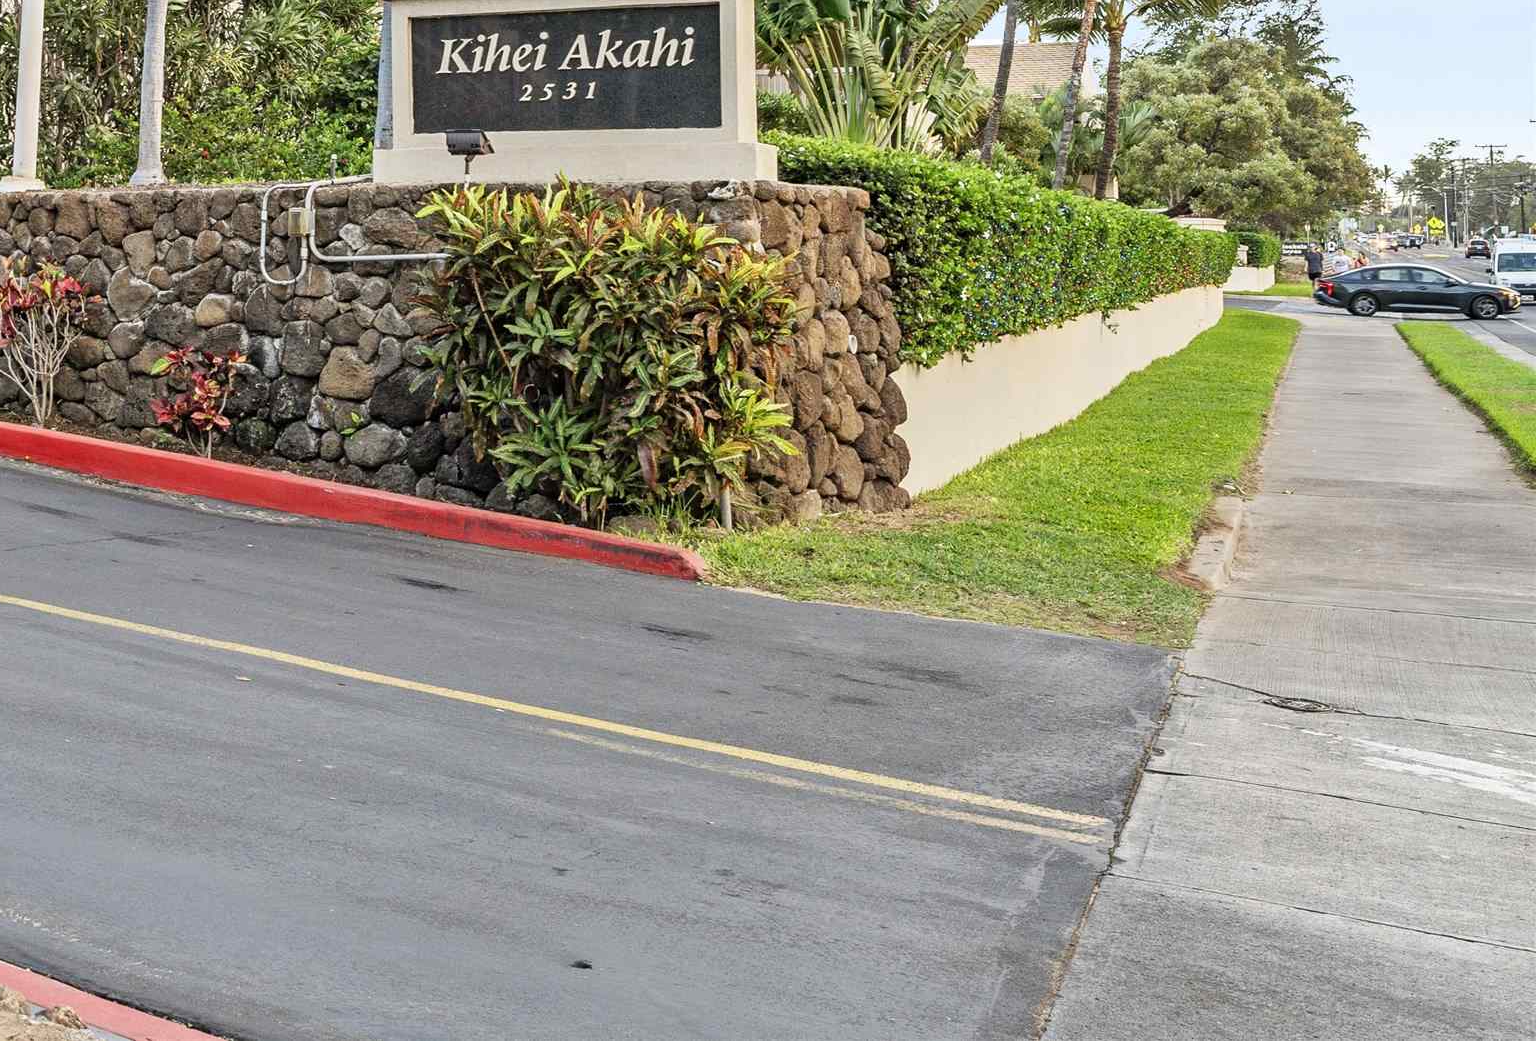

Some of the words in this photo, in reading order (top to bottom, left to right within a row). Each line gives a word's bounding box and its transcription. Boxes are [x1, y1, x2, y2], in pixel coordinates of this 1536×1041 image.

[435, 31, 550, 74] Kihei
[558, 26, 696, 70] Akahi
[519, 81, 597, 102] 2531
